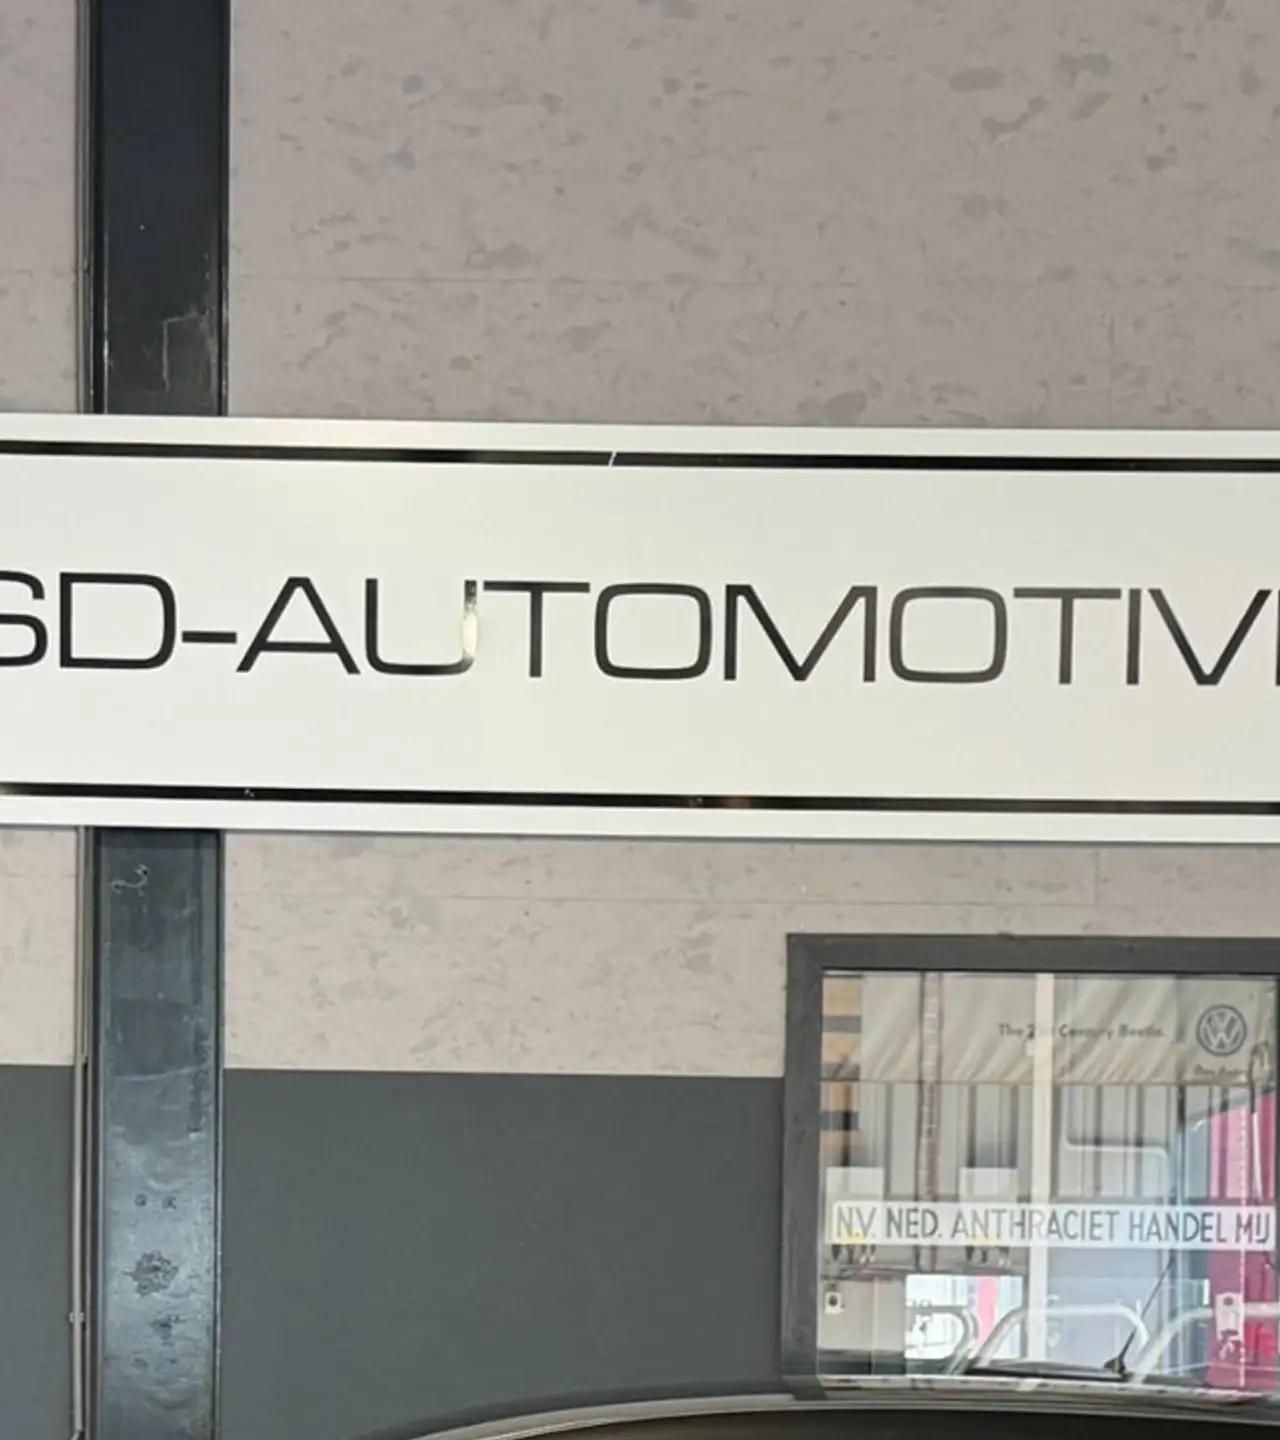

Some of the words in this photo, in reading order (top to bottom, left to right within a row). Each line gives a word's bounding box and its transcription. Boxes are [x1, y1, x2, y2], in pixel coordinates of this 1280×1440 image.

[886, 1207, 942, 1239] NED.
[951, 1208, 1121, 1242] ANTHRACIET
[1129, 1210, 1227, 1243] HANDEL
